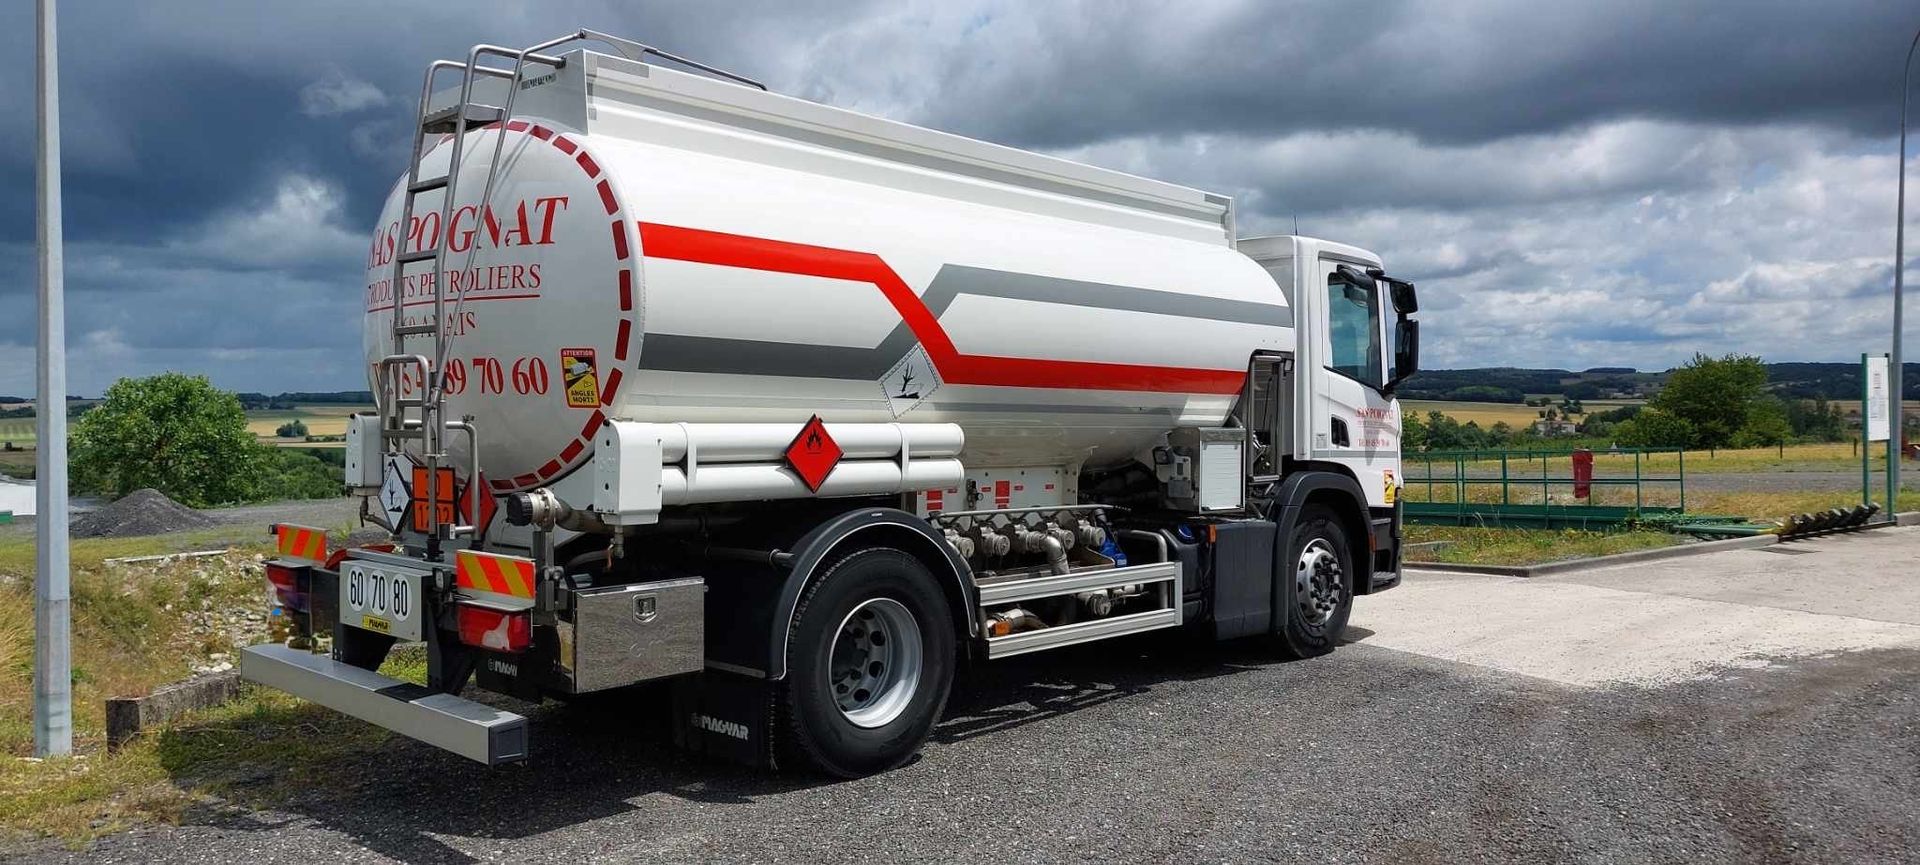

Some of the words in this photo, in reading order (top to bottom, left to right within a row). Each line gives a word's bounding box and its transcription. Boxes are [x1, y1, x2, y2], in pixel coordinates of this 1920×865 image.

[368, 221, 399, 271] SAS
[406, 197, 569, 254] POGNAT
[368, 275, 415, 305] PRODUTS
[422, 311, 477, 337] AAIS
[472, 357, 504, 395] 70
[512, 357, 549, 395] 60
[350, 570, 364, 607] 60
[371, 574, 386, 611] 70
[393, 578, 408, 617] 80
[701, 715, 749, 740] MAGYAR
